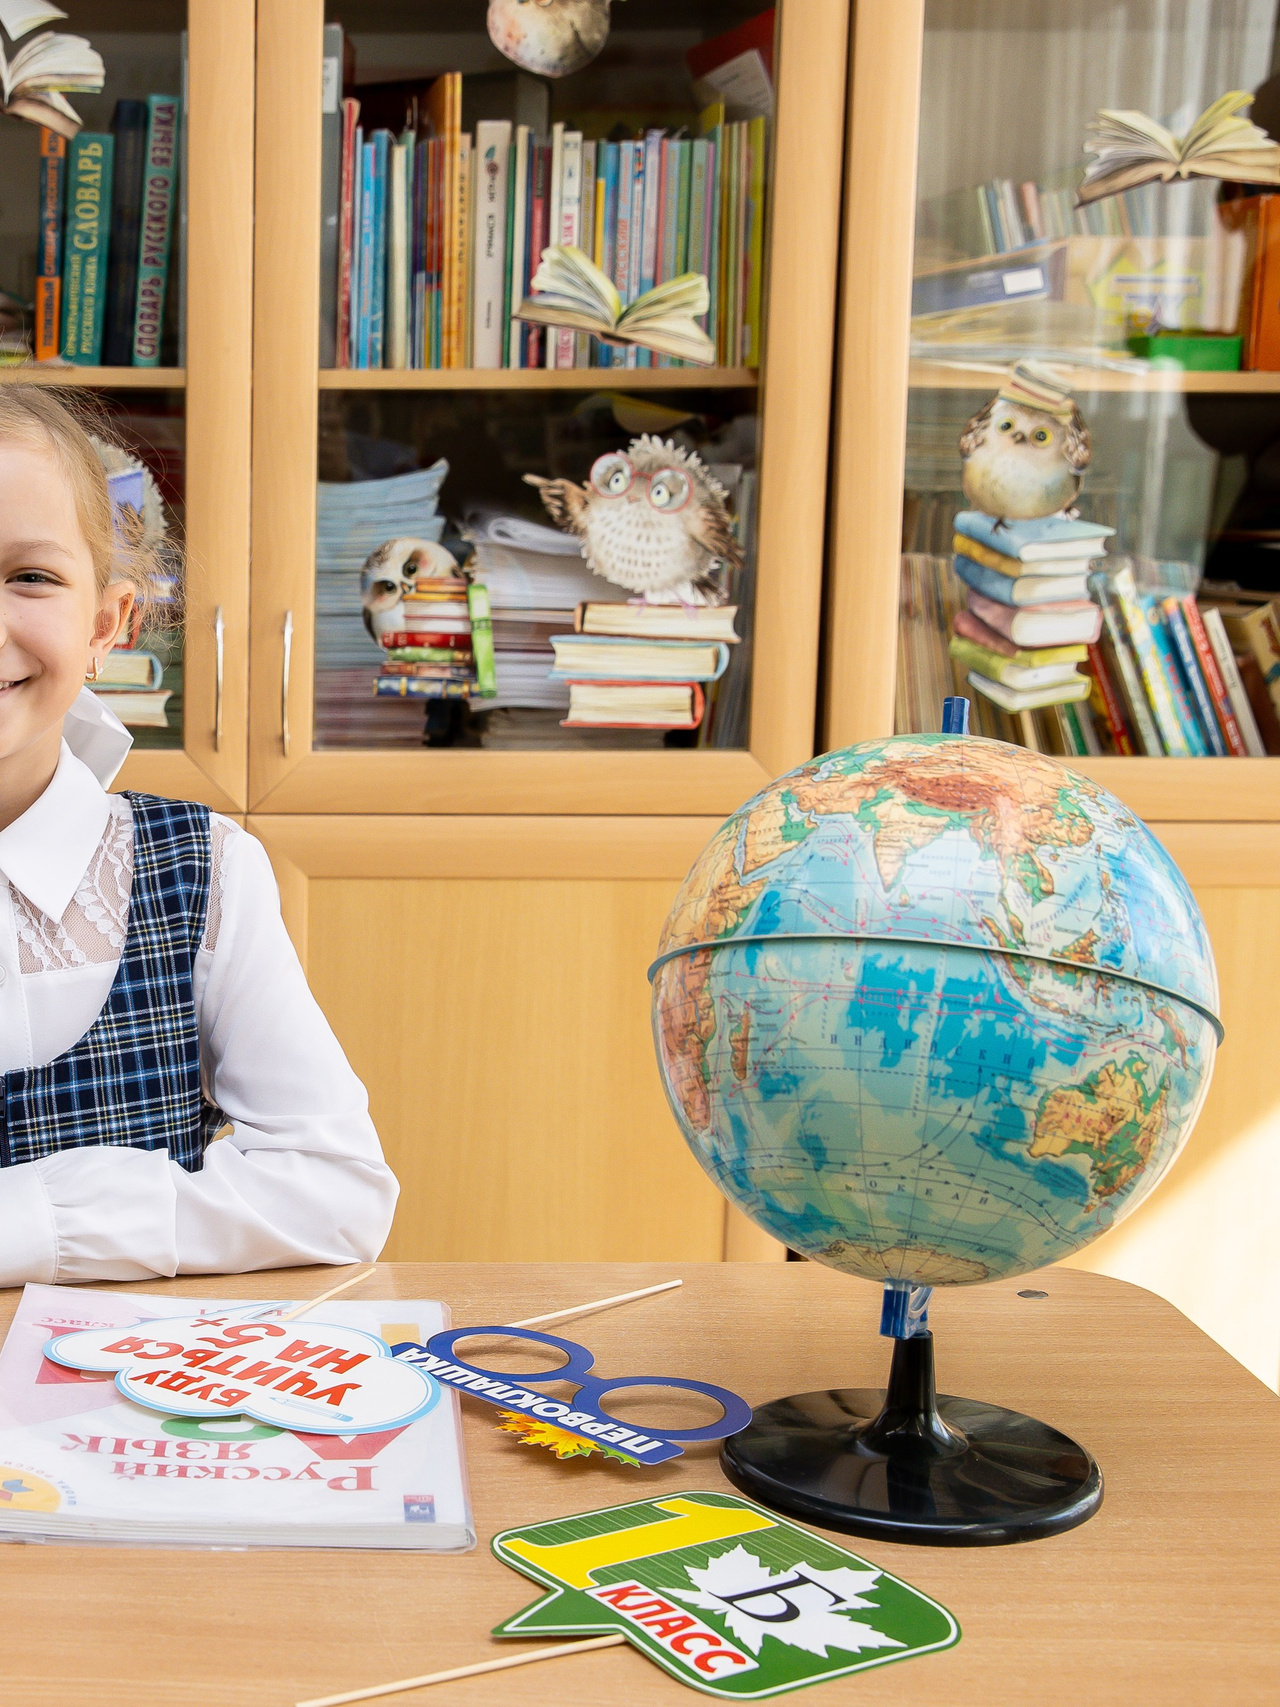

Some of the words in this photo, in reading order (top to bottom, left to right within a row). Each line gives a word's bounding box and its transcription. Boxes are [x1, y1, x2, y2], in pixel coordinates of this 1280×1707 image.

[150, 104, 176, 168] ЯЗЫКА
[73, 141, 104, 250] СЛОВАРЬ
[143, 175, 170, 268] РУССКОГО
[136, 275, 163, 359] СЛОВАРЬ
[869, 1180, 989, 1205] ОКЕАН
[99, 1334, 362, 1407] УЧИТЬСЯ
[129, 1369, 253, 1408] БУДУ
[274, 1338, 375, 1375] НА
[393, 1347, 663, 1454] ПЕРВОКЛАШКА
[109, 1460, 380, 1492] Русский
[499, 1497, 779, 1590] 1
[596, 1583, 747, 1673] КЛАСС
[708, 1570, 846, 1623] Б
